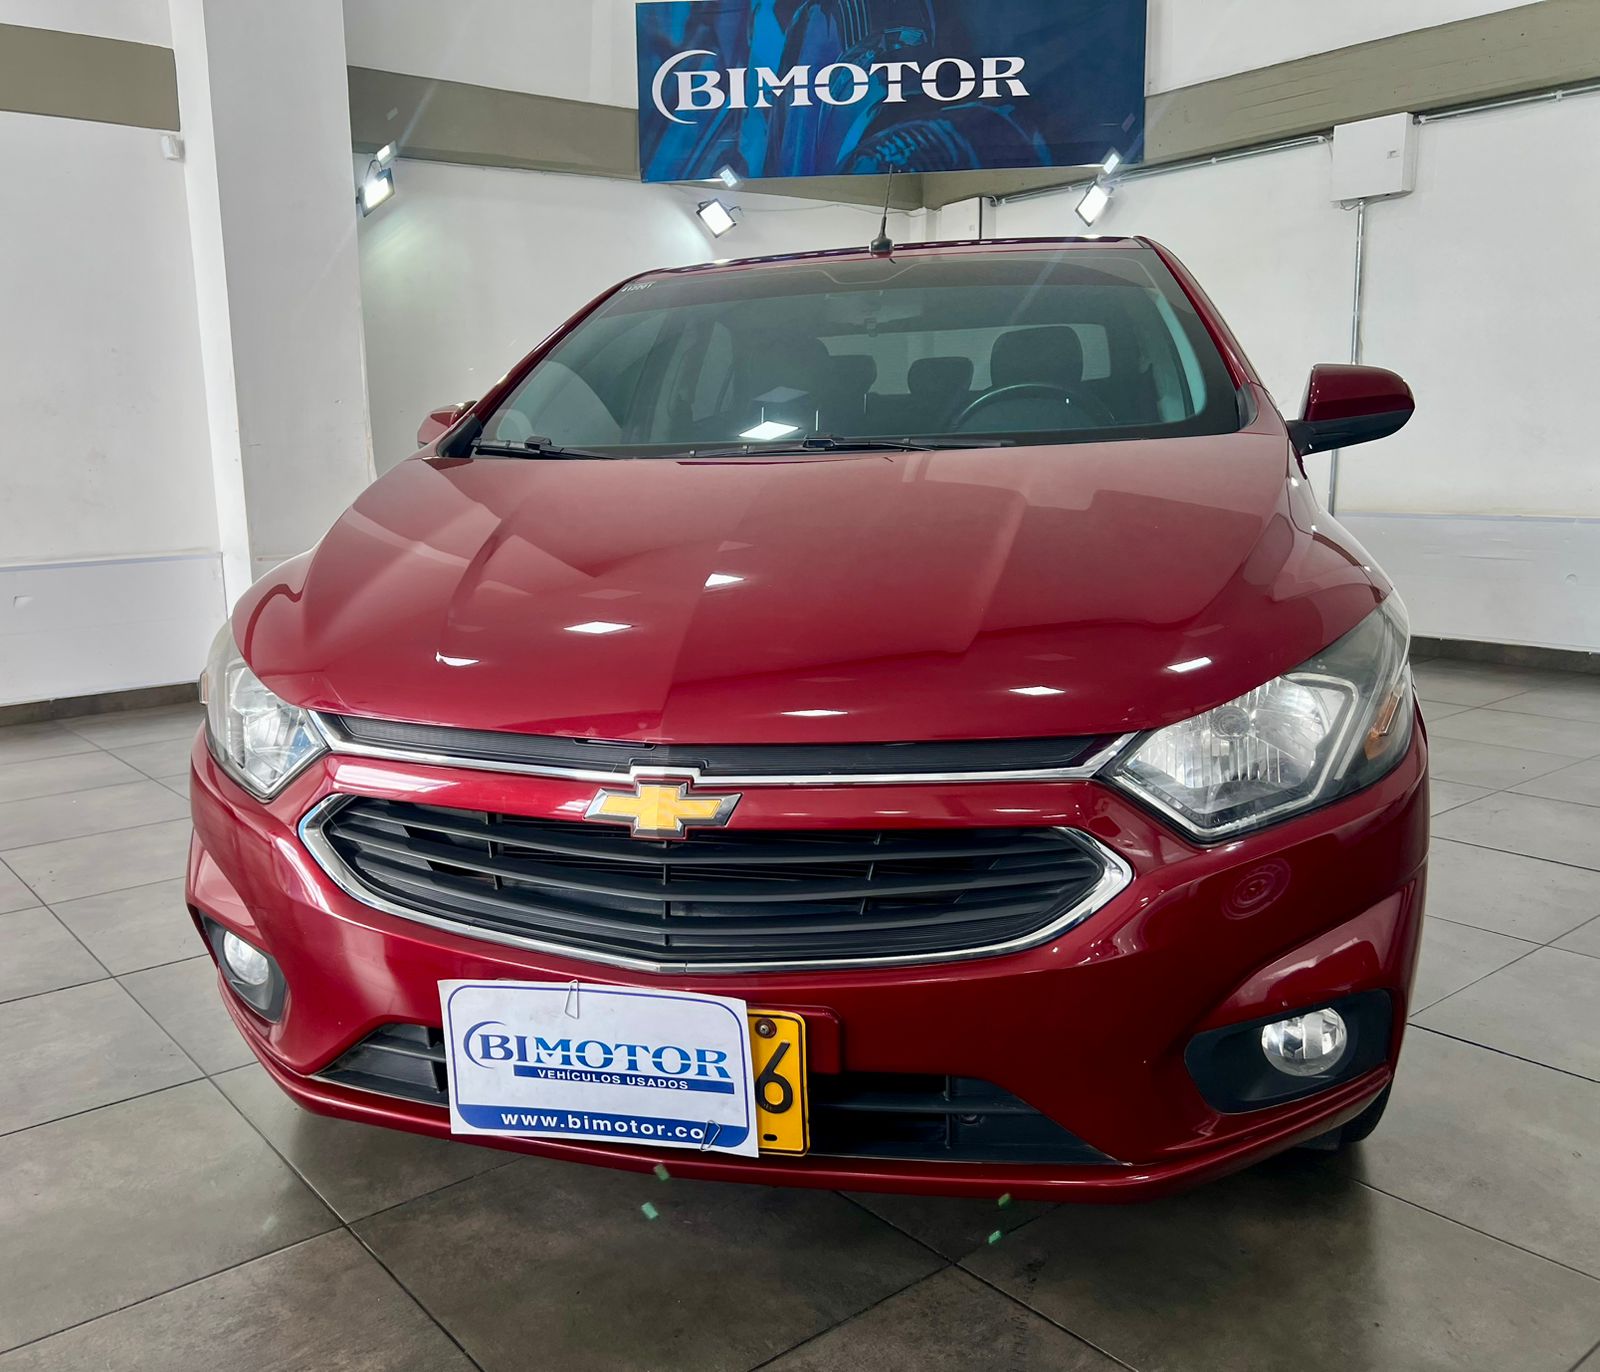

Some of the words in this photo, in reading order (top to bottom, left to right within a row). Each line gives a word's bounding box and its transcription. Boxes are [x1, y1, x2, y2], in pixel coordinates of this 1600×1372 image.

[674, 57, 1030, 111] BIMOTOR
[479, 1034, 731, 1078] BIMOTOR
[537, 1069, 621, 1084] VEHÍCULOS
[626, 1077, 688, 1089] USADOS
[501, 1113, 704, 1139] www.bimotor.co
